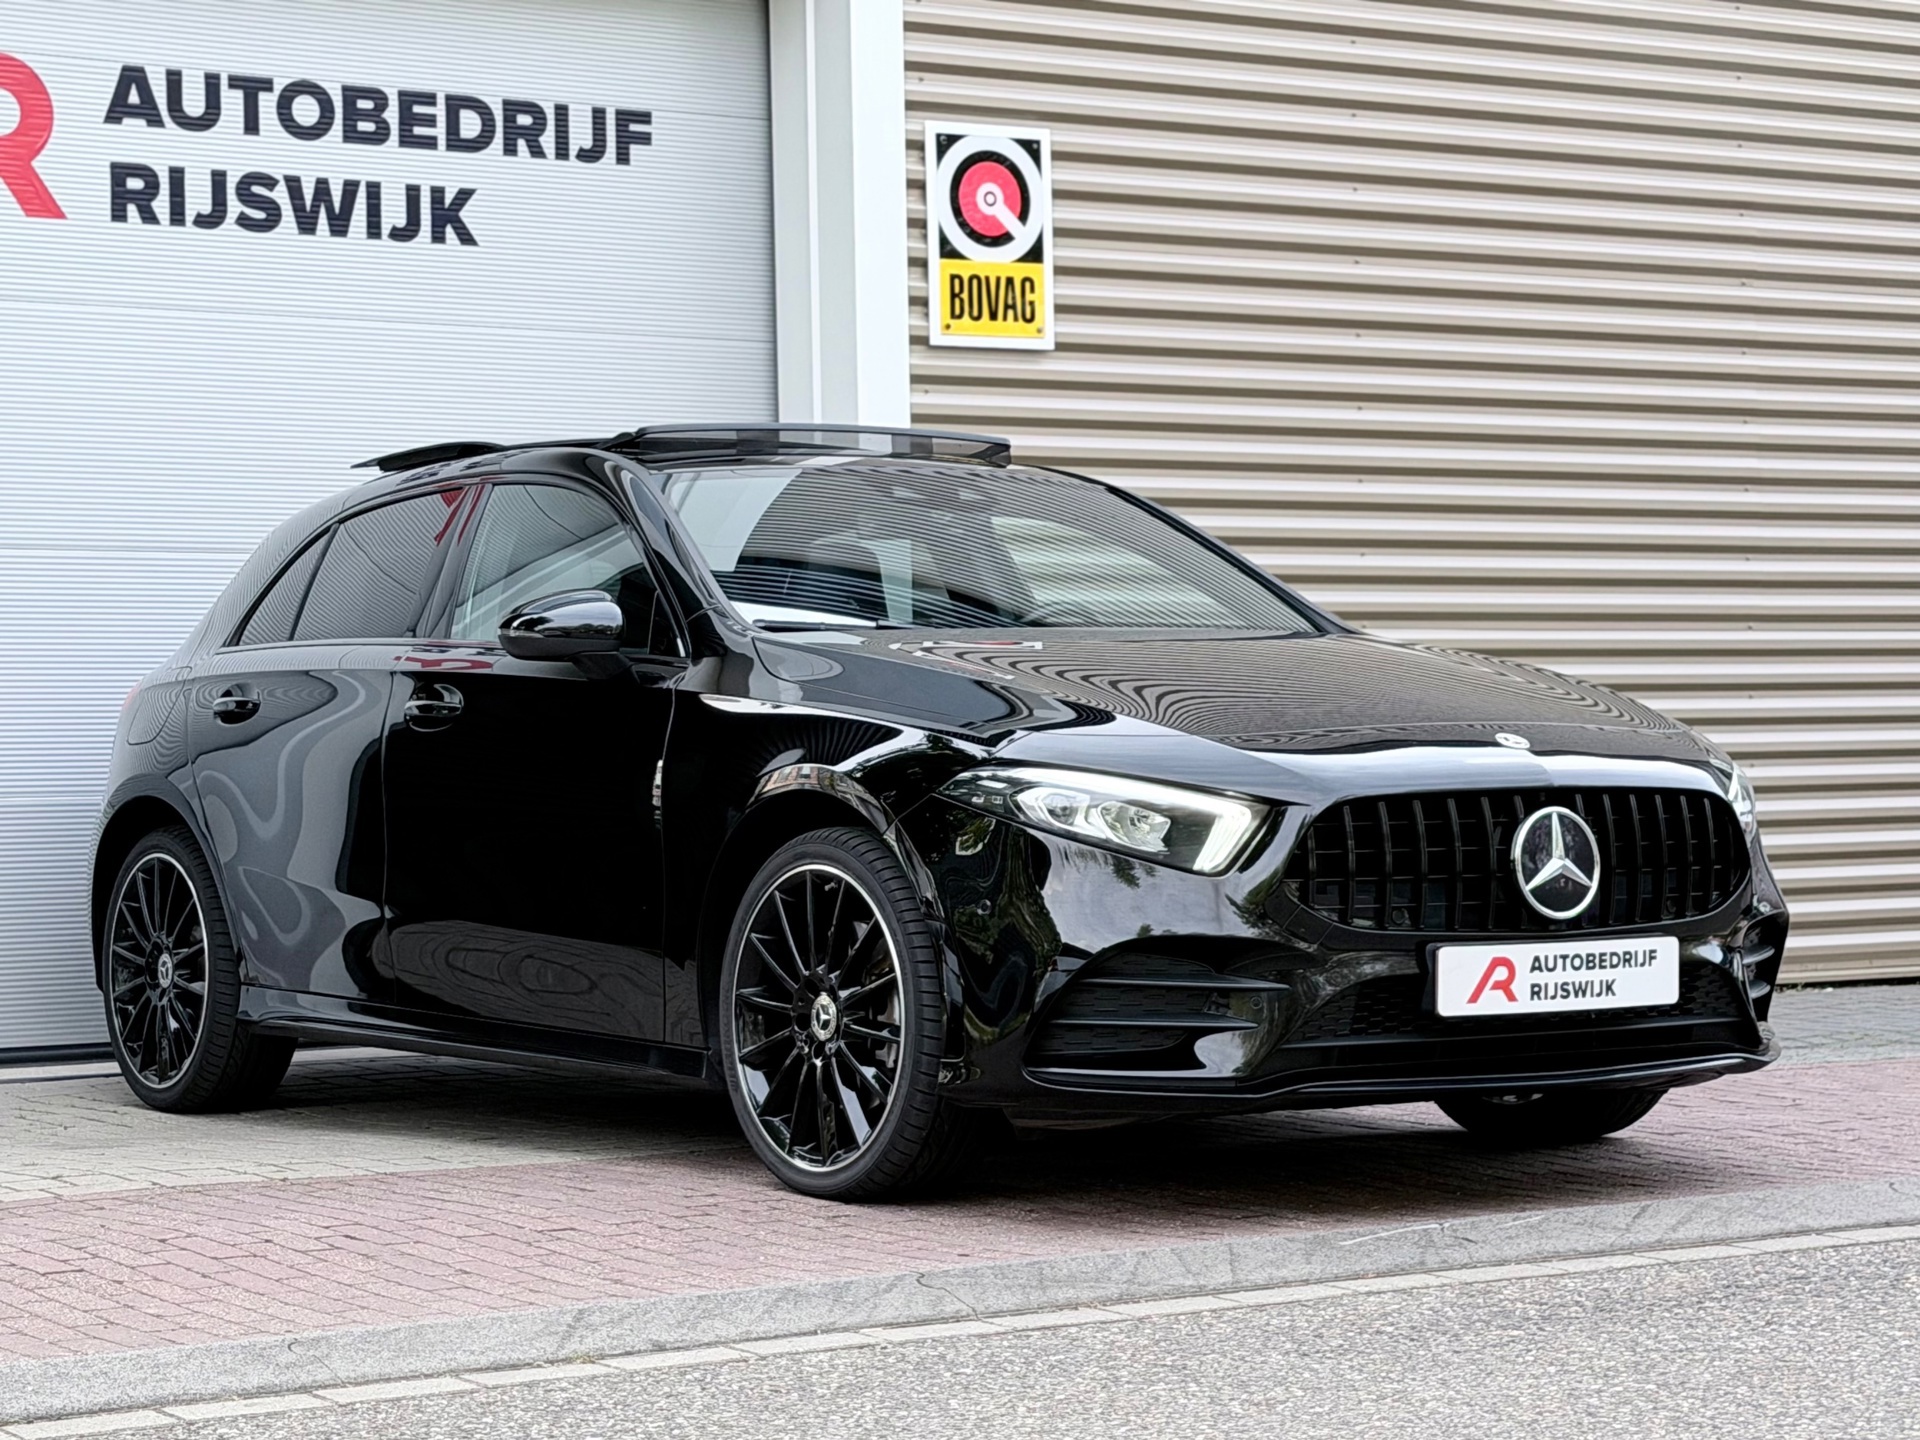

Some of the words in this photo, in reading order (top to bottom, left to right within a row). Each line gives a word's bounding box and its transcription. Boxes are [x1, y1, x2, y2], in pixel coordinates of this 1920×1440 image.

[104, 64, 652, 166] AUTOBEDRIJF
[109, 161, 480, 247] RIJSWIJK
[949, 273, 1036, 324] BOVAG
[1529, 949, 1658, 974] AUTOBEDRIJF
[1529, 979, 1617, 1001] RIJSWIJK
